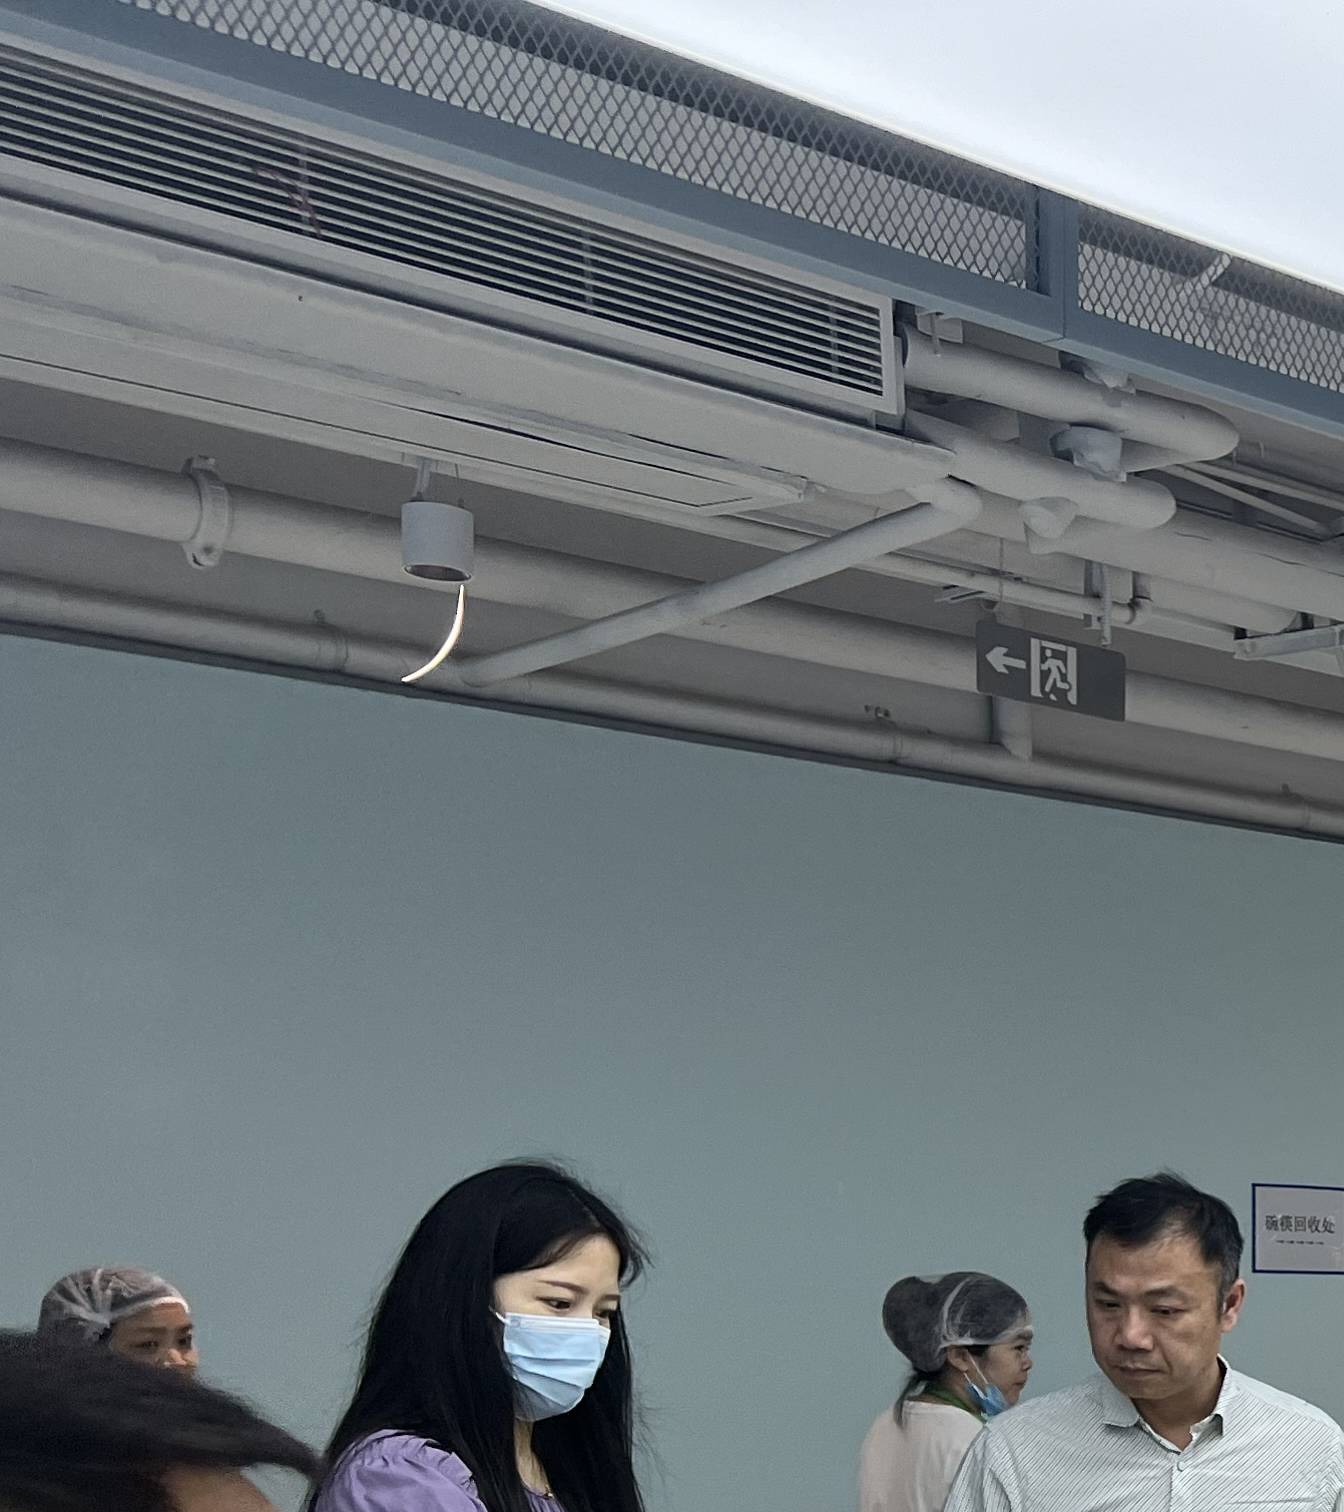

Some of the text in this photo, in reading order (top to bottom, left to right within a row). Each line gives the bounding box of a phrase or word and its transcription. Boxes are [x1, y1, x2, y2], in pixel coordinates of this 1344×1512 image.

[1264, 1214, 1335, 1234] 碗筷回收处
